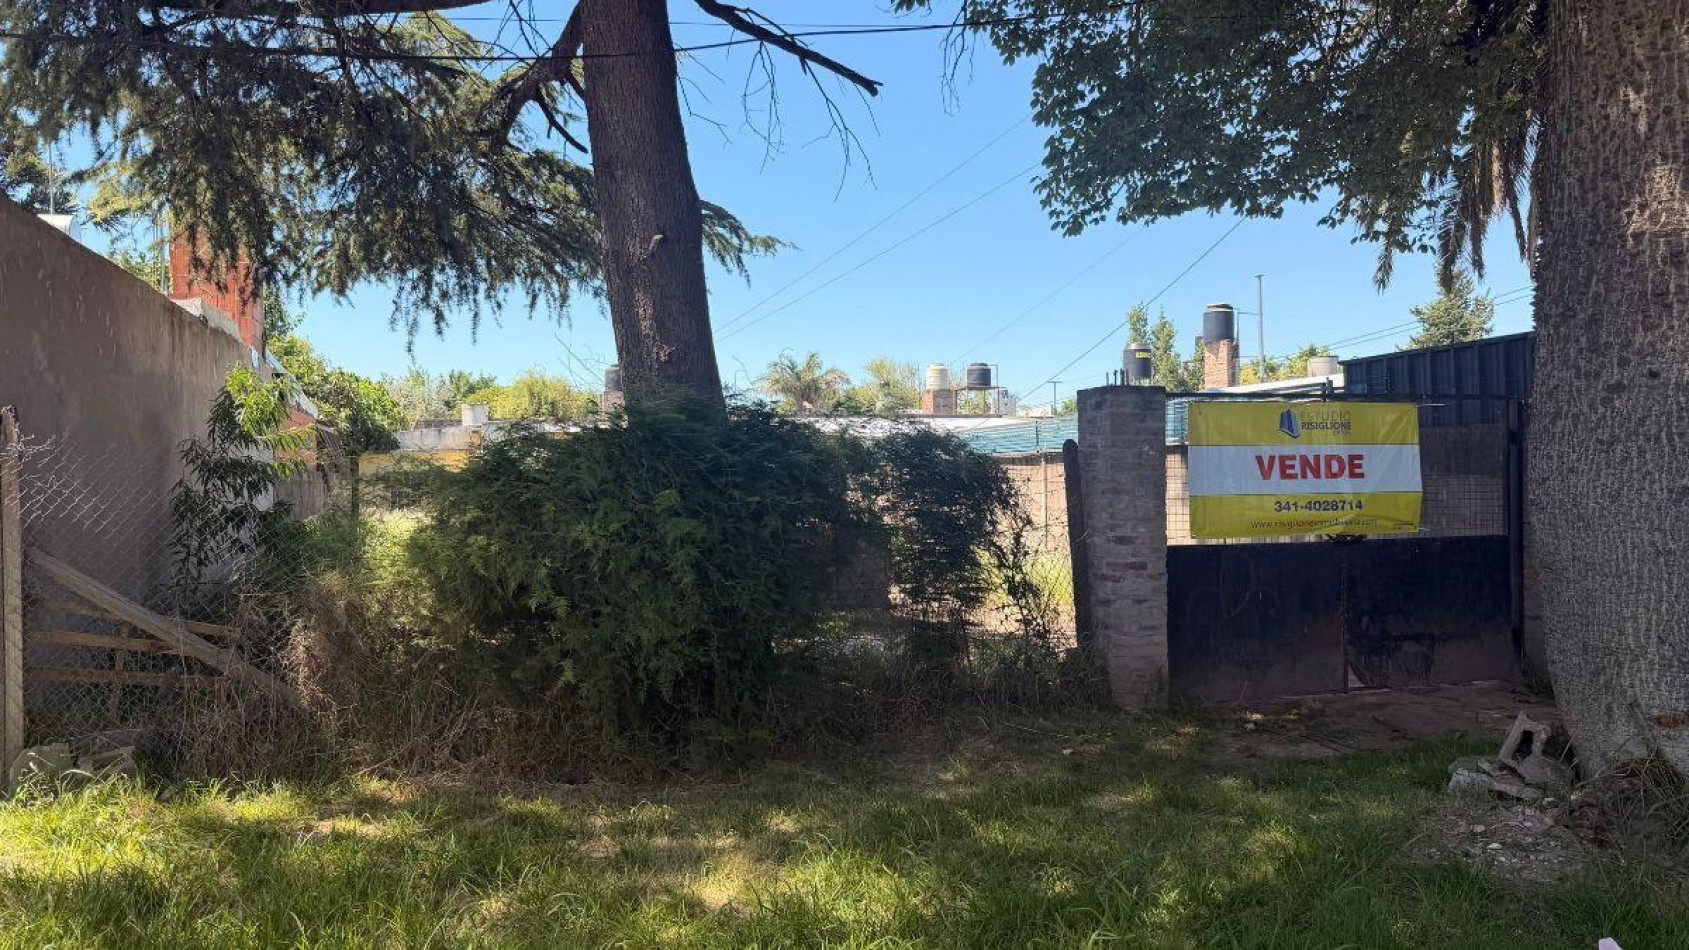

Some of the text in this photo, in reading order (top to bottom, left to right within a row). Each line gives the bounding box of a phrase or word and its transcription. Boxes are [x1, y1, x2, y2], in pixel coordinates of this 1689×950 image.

[1300, 410, 1352, 421] ESTUDIO
[1301, 421, 1352, 430] RISIGLIONE
[1255, 454, 1365, 480] VENDE
[1274, 500, 1364, 512] 341-4028714
